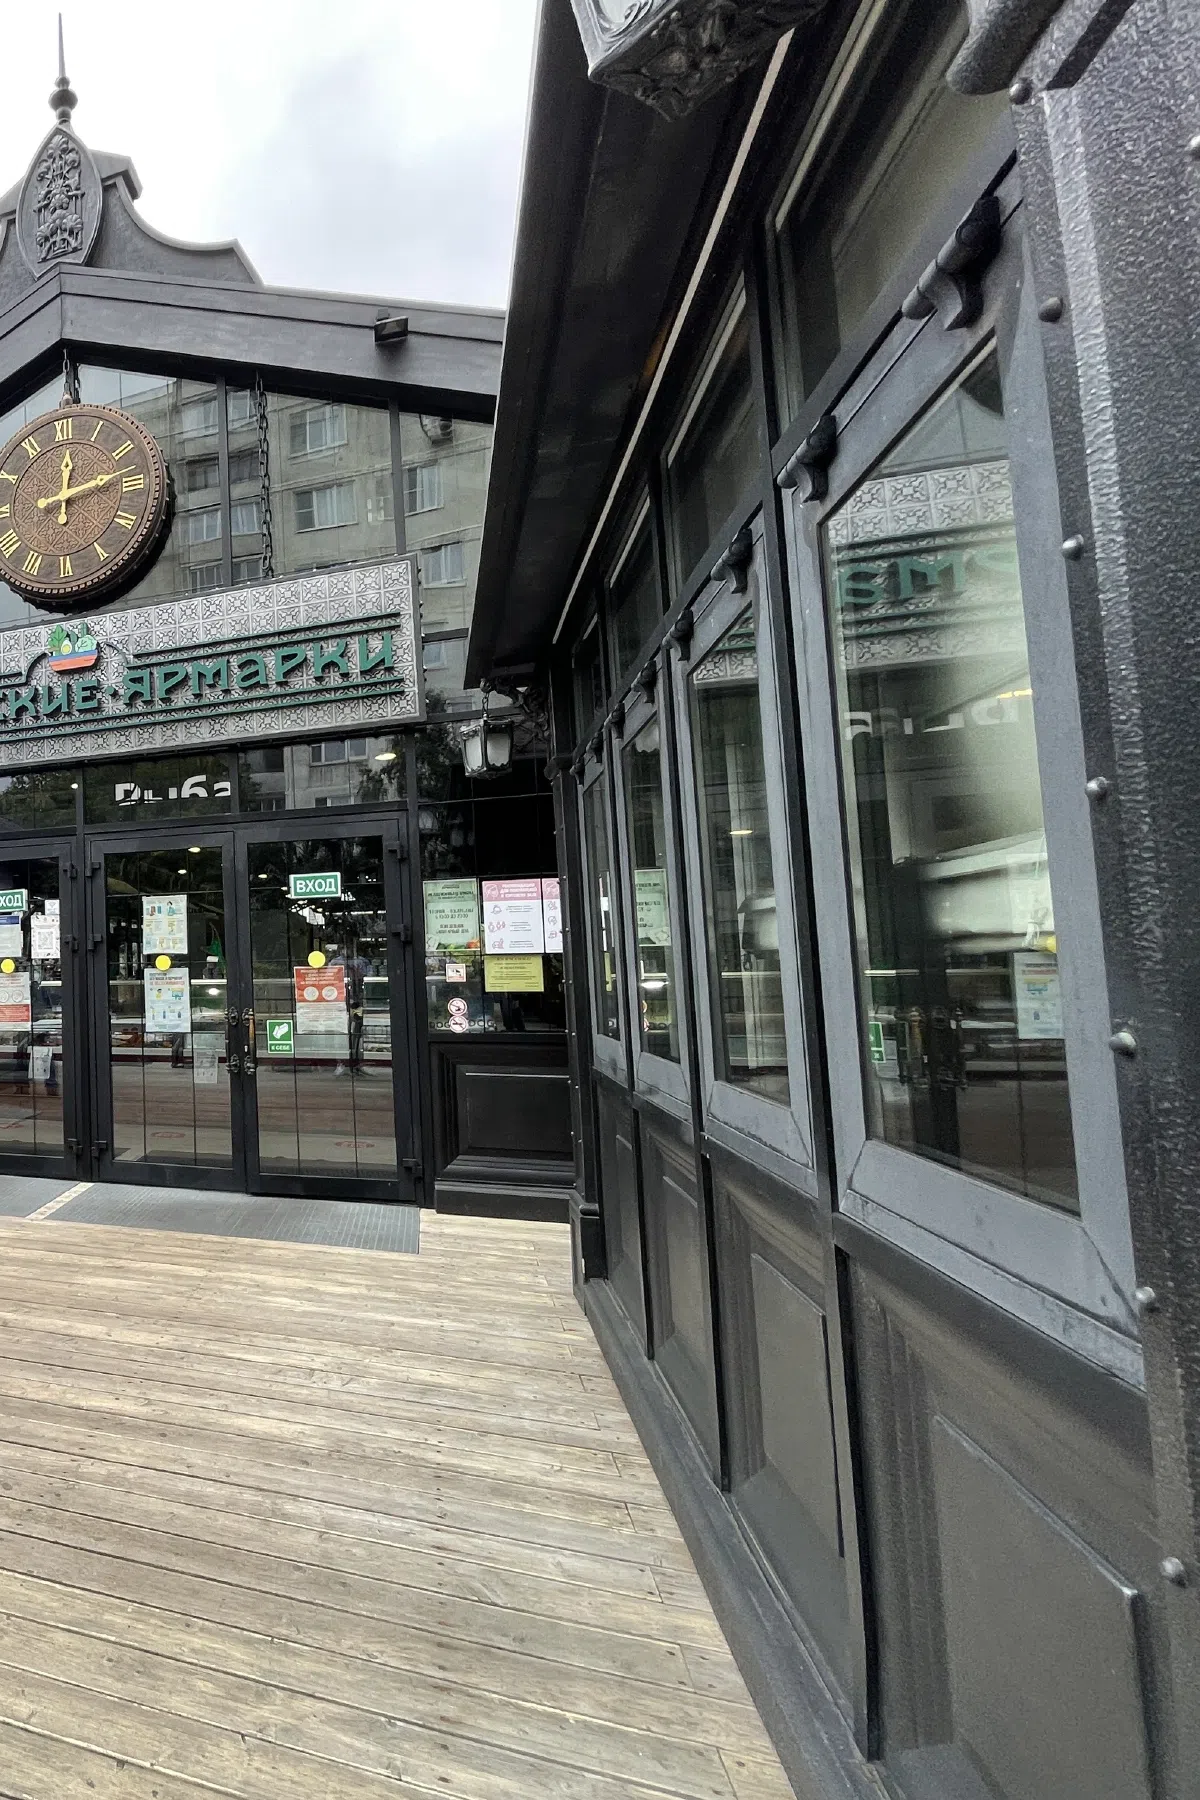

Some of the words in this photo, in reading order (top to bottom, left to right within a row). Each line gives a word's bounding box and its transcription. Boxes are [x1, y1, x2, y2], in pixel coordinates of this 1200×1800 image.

[54, 418, 73, 442] XII
[21, 436, 42, 459] XI
[112, 441, 134, 460] II
[0, 470, 18, 484] X
[123, 474, 144, 492] III
[94, 542, 109, 561] V
[296, 878, 336, 893] ВХОД
